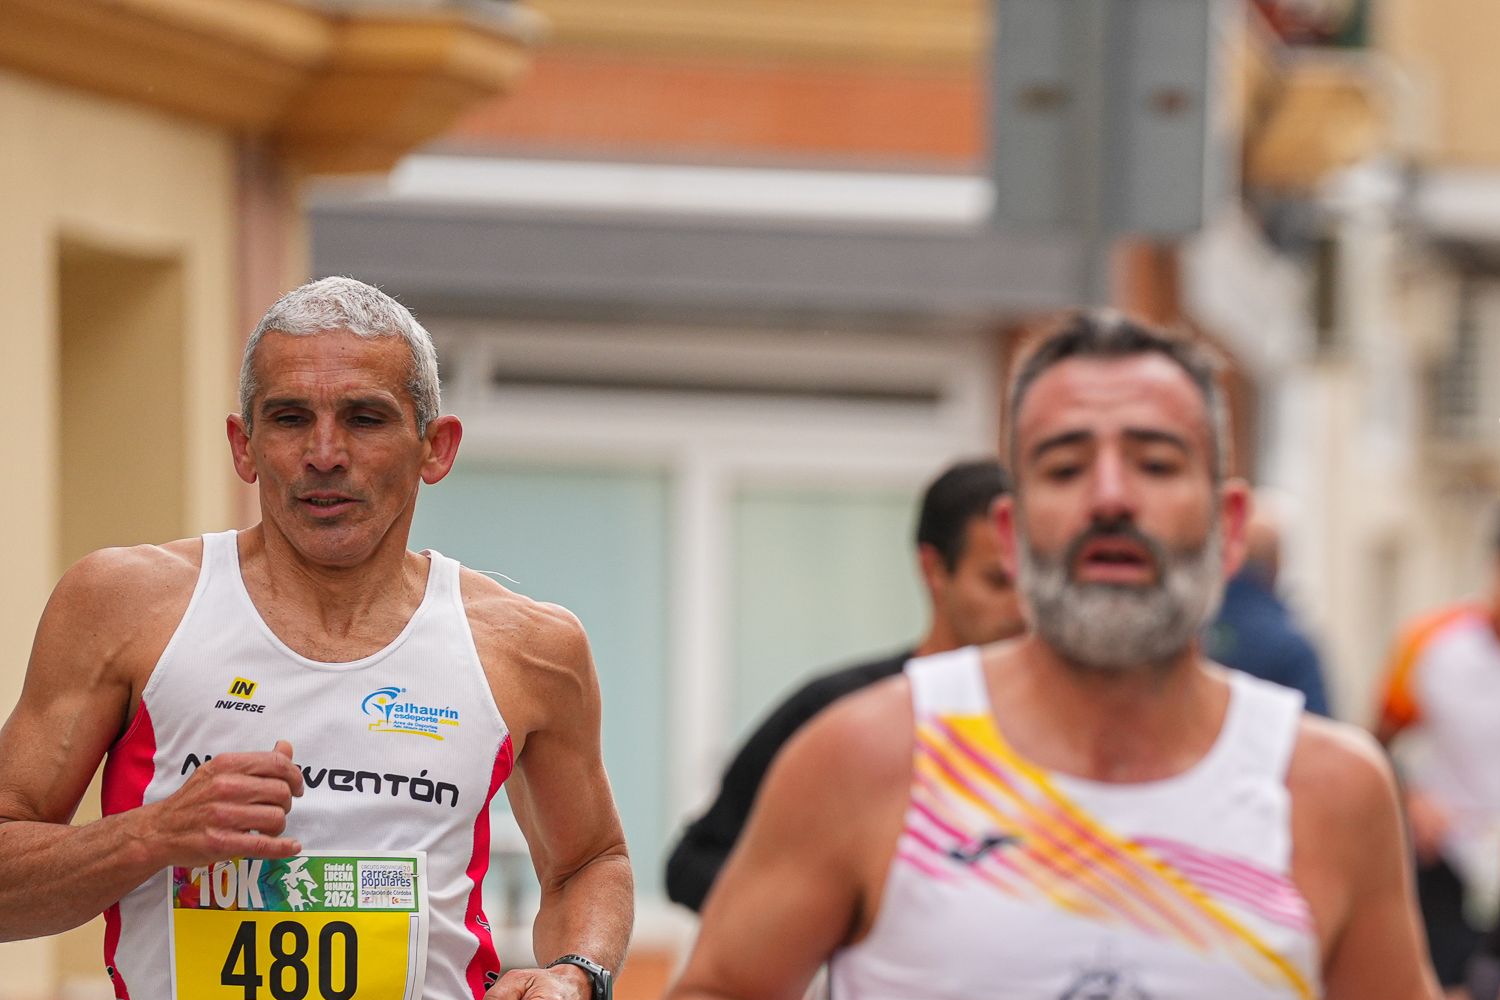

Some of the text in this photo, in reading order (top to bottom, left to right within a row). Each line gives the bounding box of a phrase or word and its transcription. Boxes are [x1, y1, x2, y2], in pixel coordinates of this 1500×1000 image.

[230, 680, 255, 696] IN
[214, 699, 266, 713] INVERSE
[395, 703, 459, 719] alhaurín
[345, 863, 354, 872] de
[324, 871, 354, 881] LUCENA
[361, 870, 403, 879] carreras
[191, 858, 264, 909] 10K
[361, 877, 411, 889] populares
[324, 891, 355, 908] 2026
[361, 889, 386, 897] Diputación
